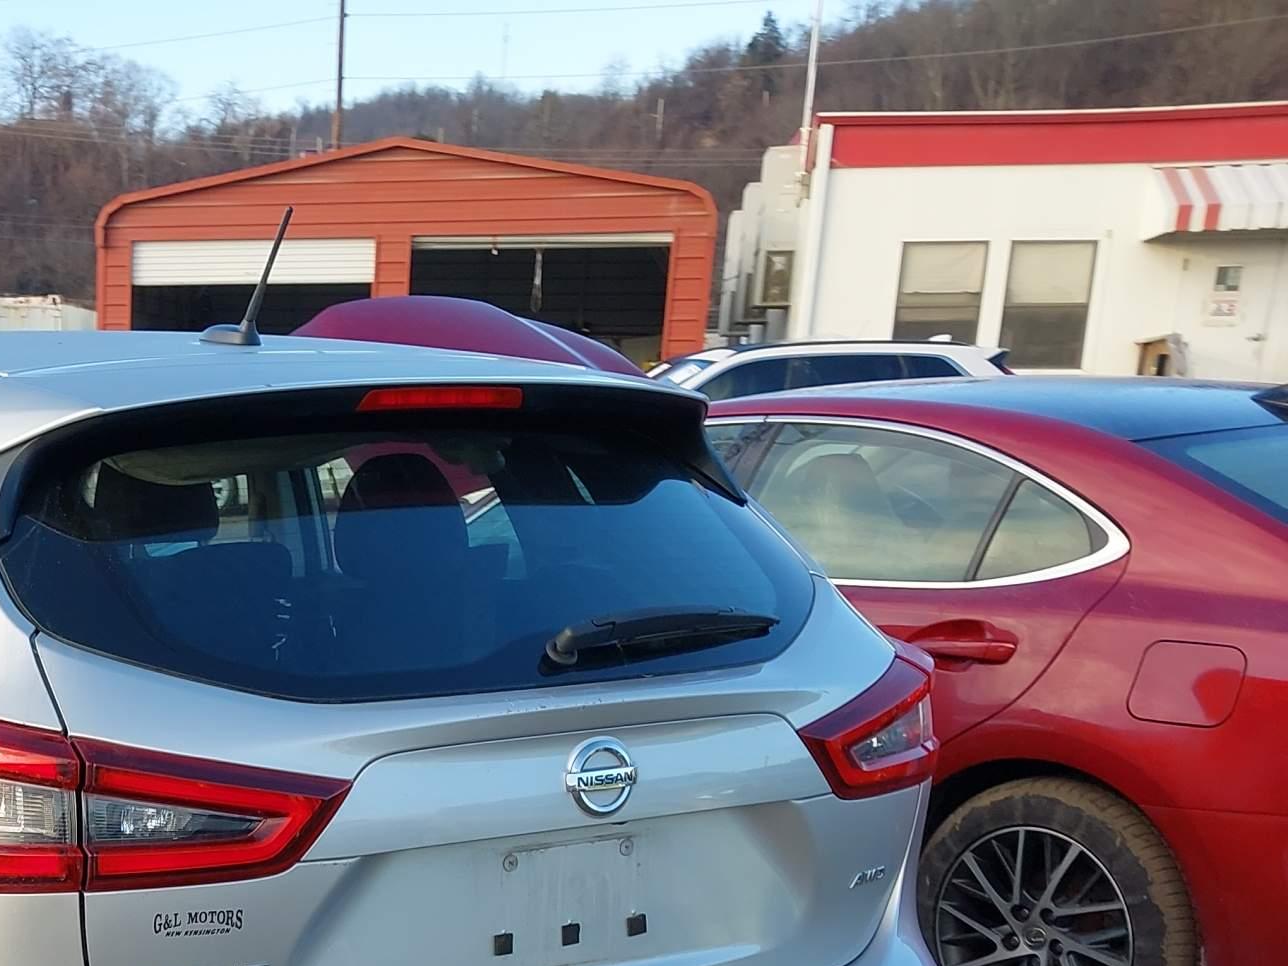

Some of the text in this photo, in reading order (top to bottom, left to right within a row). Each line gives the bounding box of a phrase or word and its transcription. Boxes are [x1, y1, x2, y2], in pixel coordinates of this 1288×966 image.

[576, 770, 634, 788] NISSAN
[153, 909, 244, 935] G&L MOTORS
[165, 929, 183, 938] NEW
